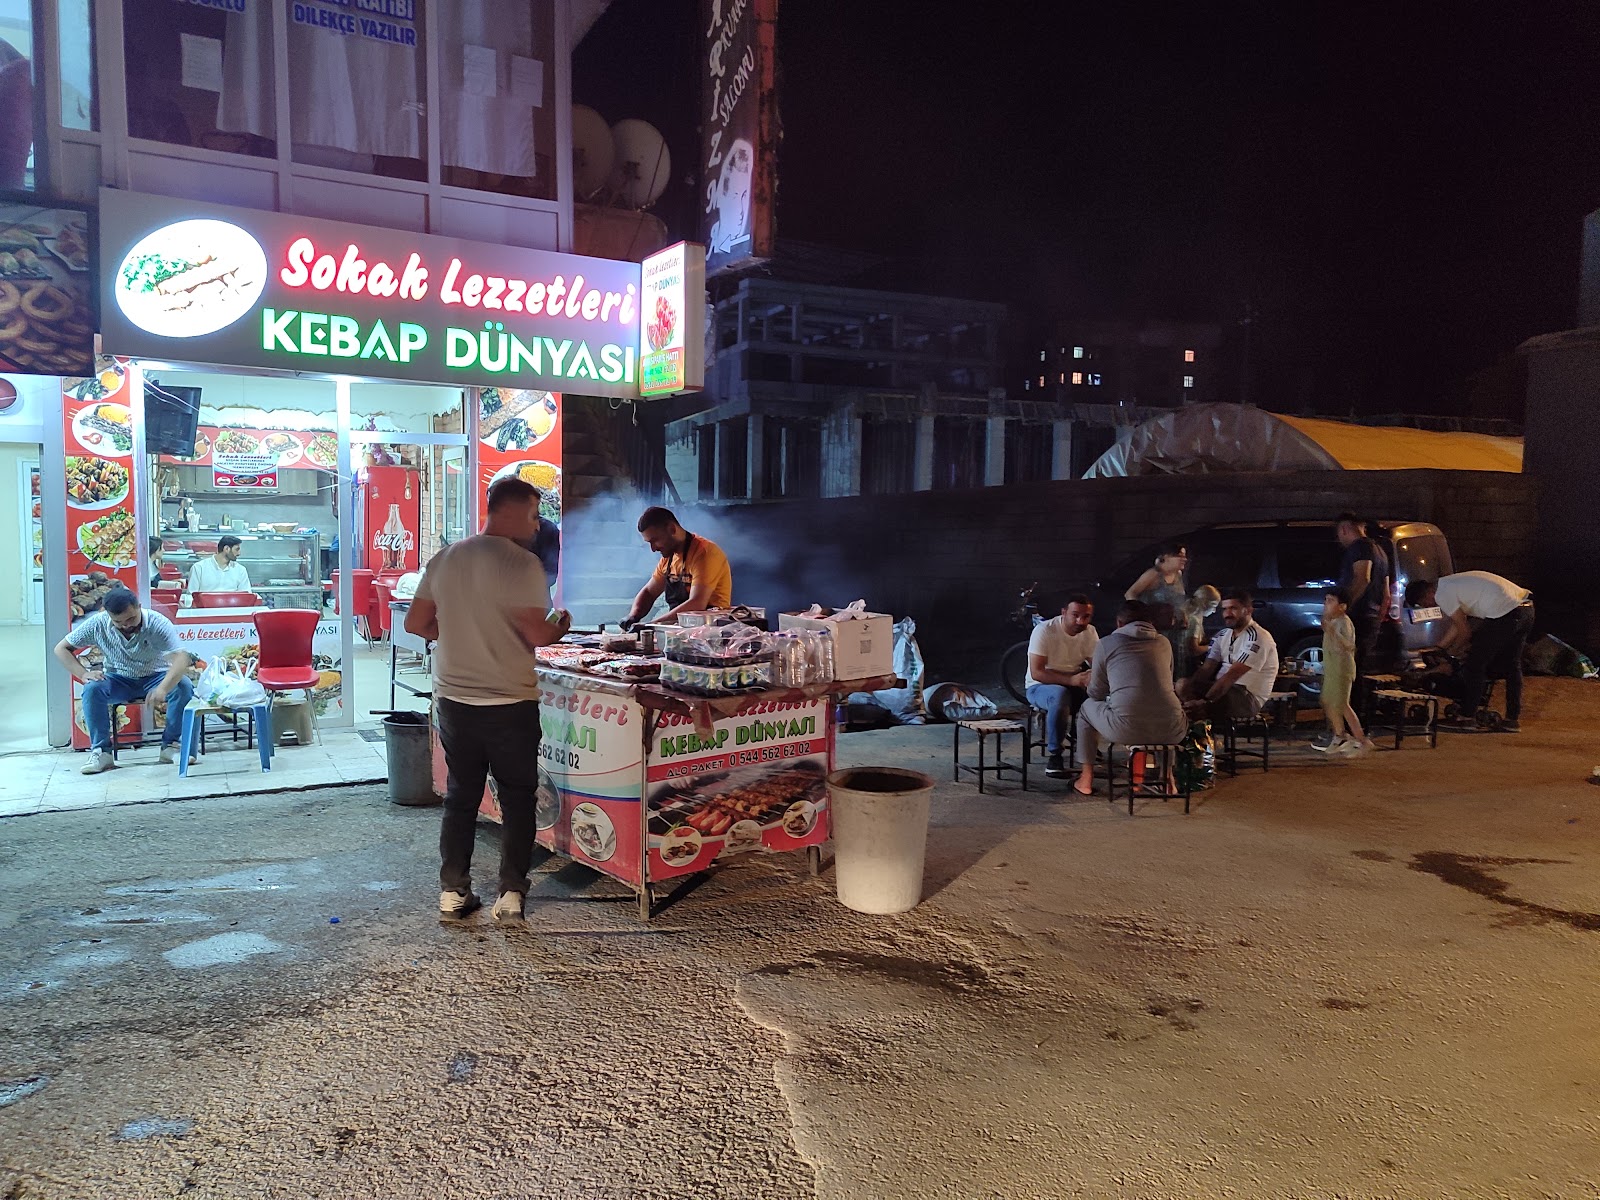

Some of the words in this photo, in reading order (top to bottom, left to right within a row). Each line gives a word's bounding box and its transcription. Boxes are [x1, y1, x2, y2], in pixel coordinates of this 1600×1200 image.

[360, 18, 416, 46] YAZILIR
[280, 237, 429, 300] Sokak
[440, 258, 637, 325] Lezzetleri
[262, 308, 428, 363] KEBAP
[446, 320, 635, 384] DÜNYASI
[196, 628, 245, 640] Lezetleri
[314, 626, 338, 636] YASI
[735, 716, 816, 746] DÜNYASI
[555, 747, 566, 766] 62
[568, 751, 580, 770] 02
[666, 767, 688, 778] ALO
[691, 760, 724, 773] PAKET
[729, 755, 736, 766] 0
[739, 750, 759, 764] 544
[762, 747, 780, 761] 562
[783, 744, 795, 757] 62
[799, 742, 811, 754] 02
